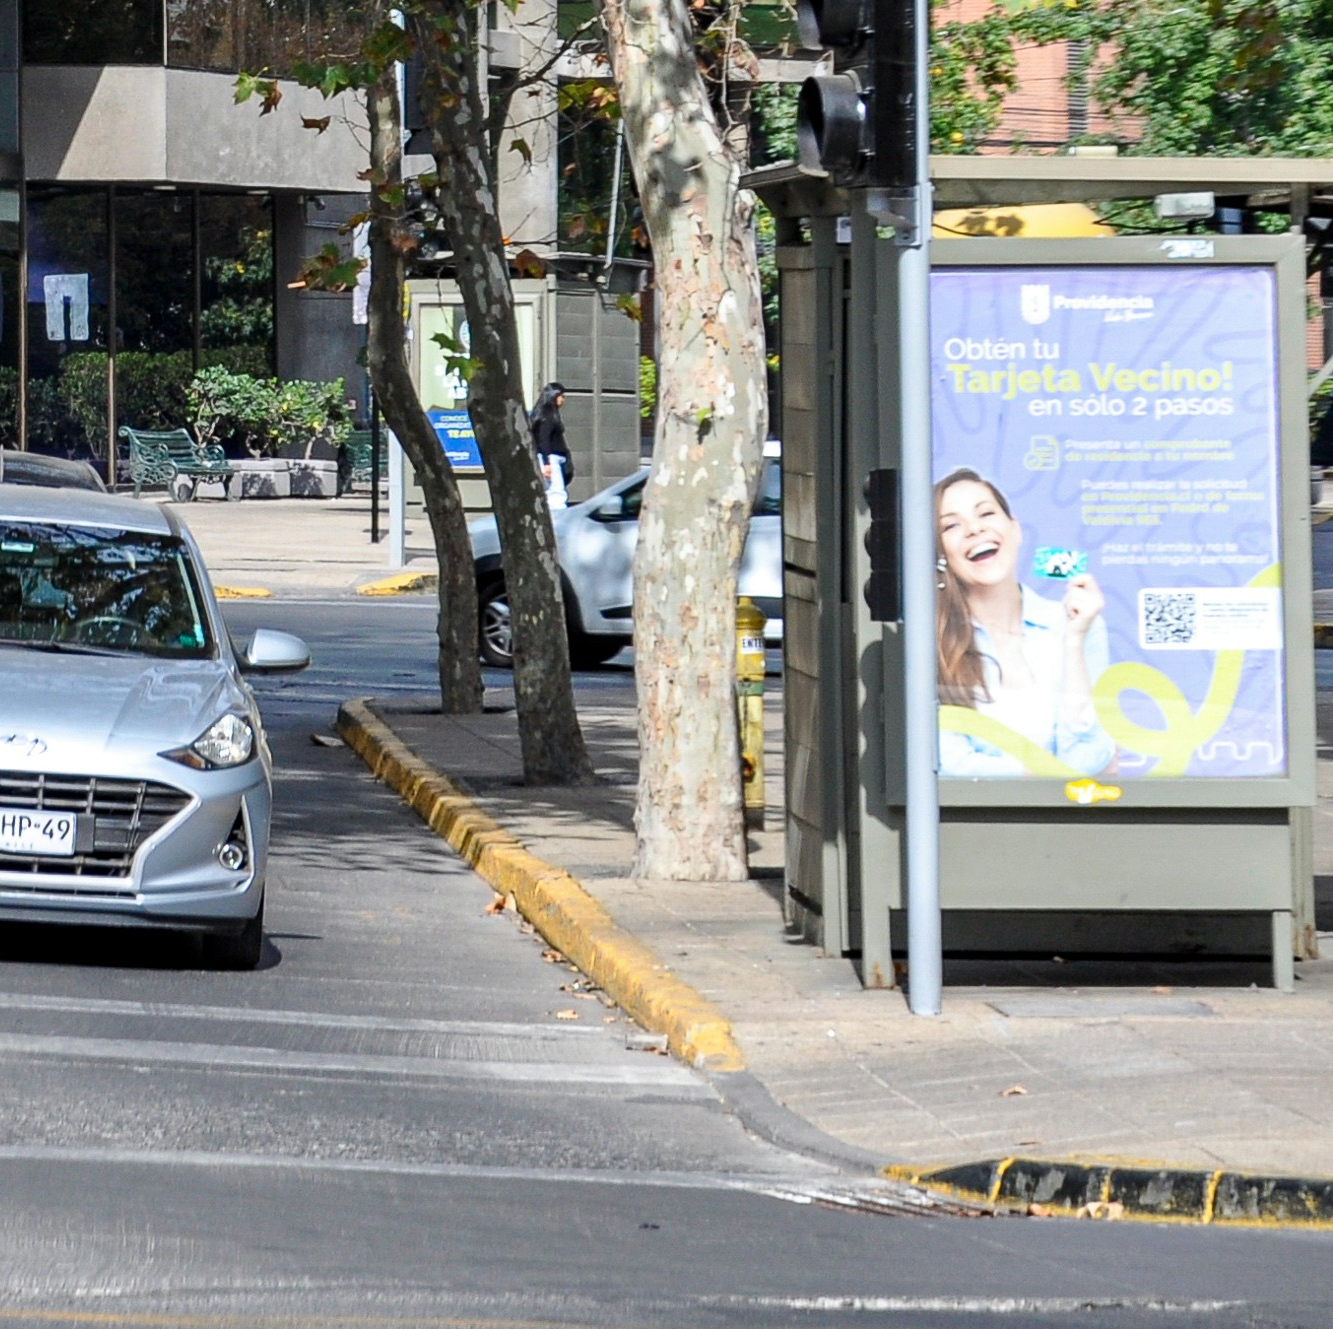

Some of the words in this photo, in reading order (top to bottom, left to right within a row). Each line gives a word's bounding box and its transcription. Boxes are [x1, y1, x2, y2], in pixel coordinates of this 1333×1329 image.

[1053, 295, 1154, 310] Providencia
[944, 337, 1025, 360] Obtén
[1033, 341, 1060, 360] tu
[946, 363, 1081, 400] Tarjeta
[1088, 361, 1233, 392] Vecino!
[1028, 399, 1062, 416] en
[1070, 393, 1126, 416] sólo
[1131, 399, 1148, 416] 2
[1155, 397, 1233, 420] pasos
